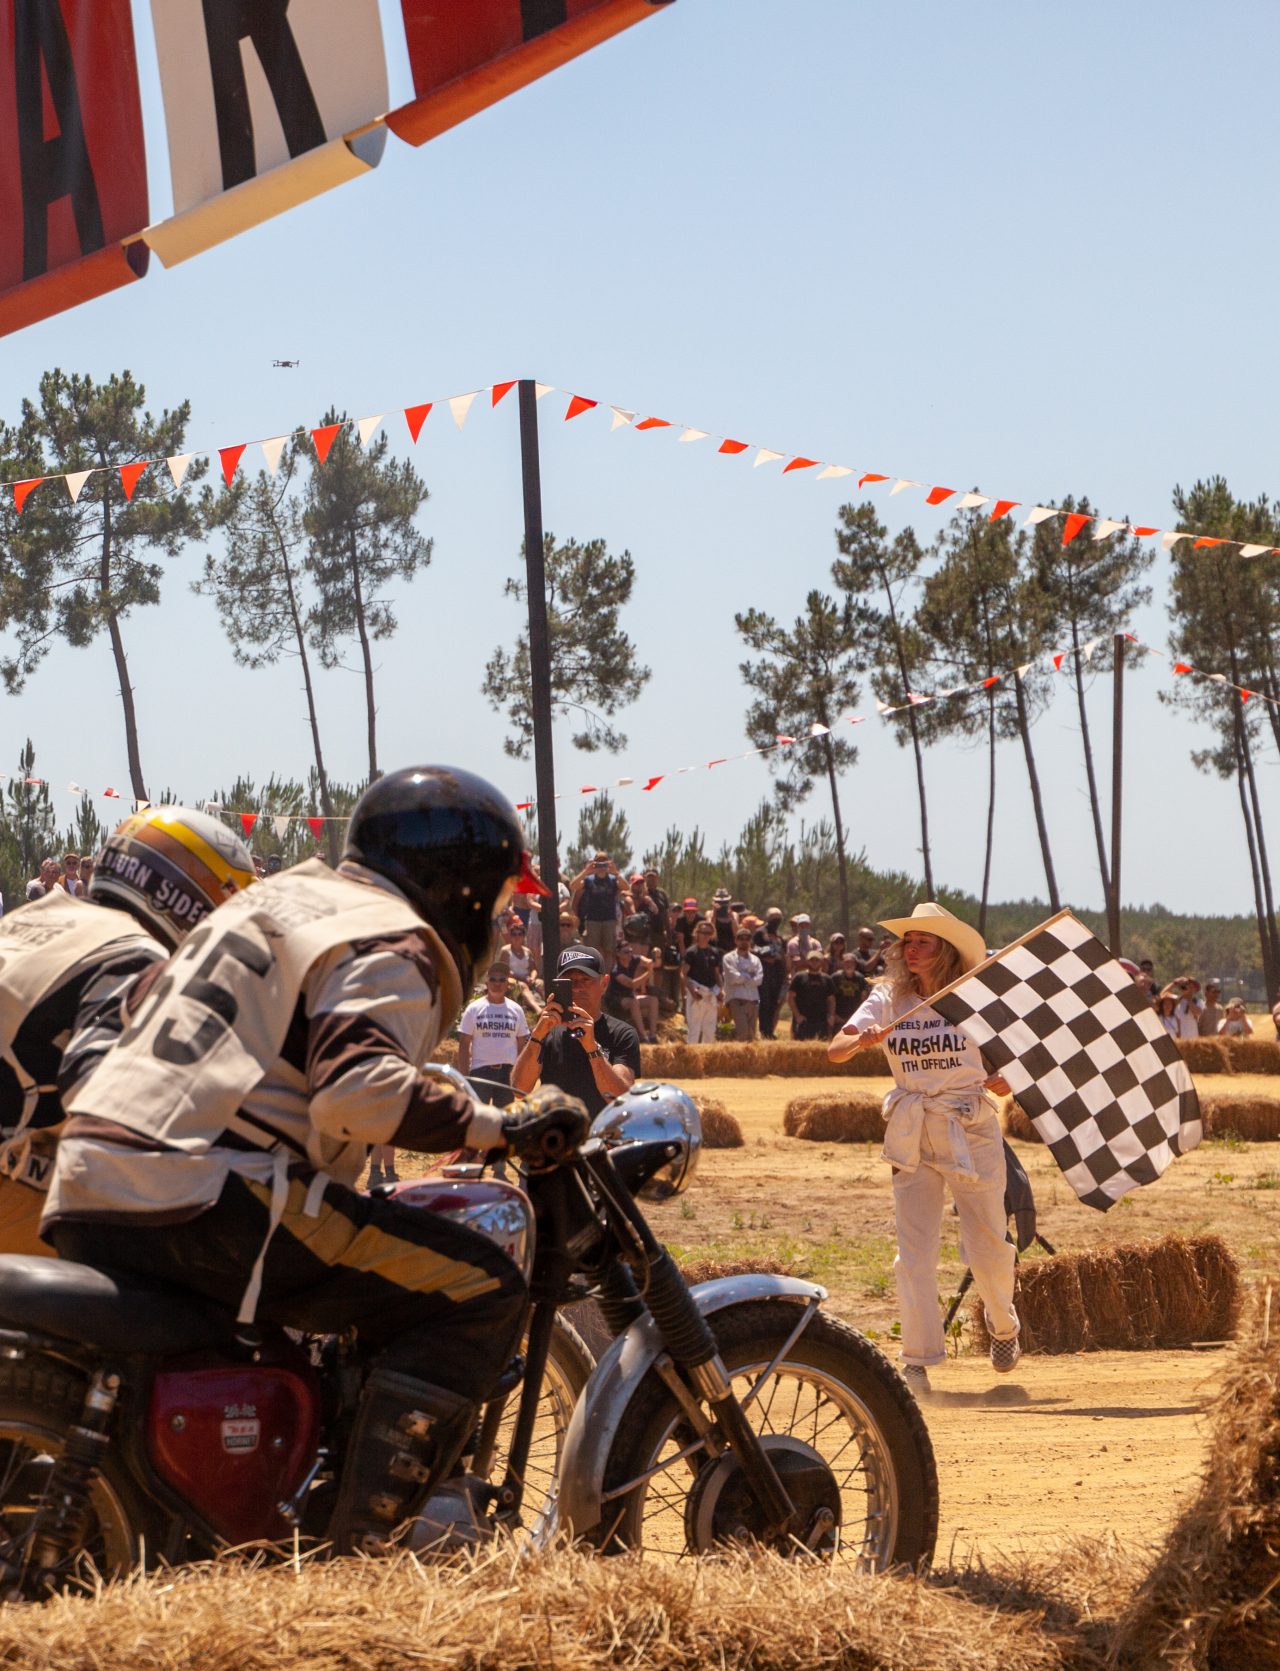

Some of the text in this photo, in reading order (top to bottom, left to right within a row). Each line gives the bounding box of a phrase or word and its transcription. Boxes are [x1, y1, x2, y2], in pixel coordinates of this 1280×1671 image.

[893, 1021, 920, 1031] HEELS
[923, 1020, 940, 1030] AND
[887, 1034, 967, 1056] MARSHALL
[921, 1057, 962, 1070] OFFICIAL
